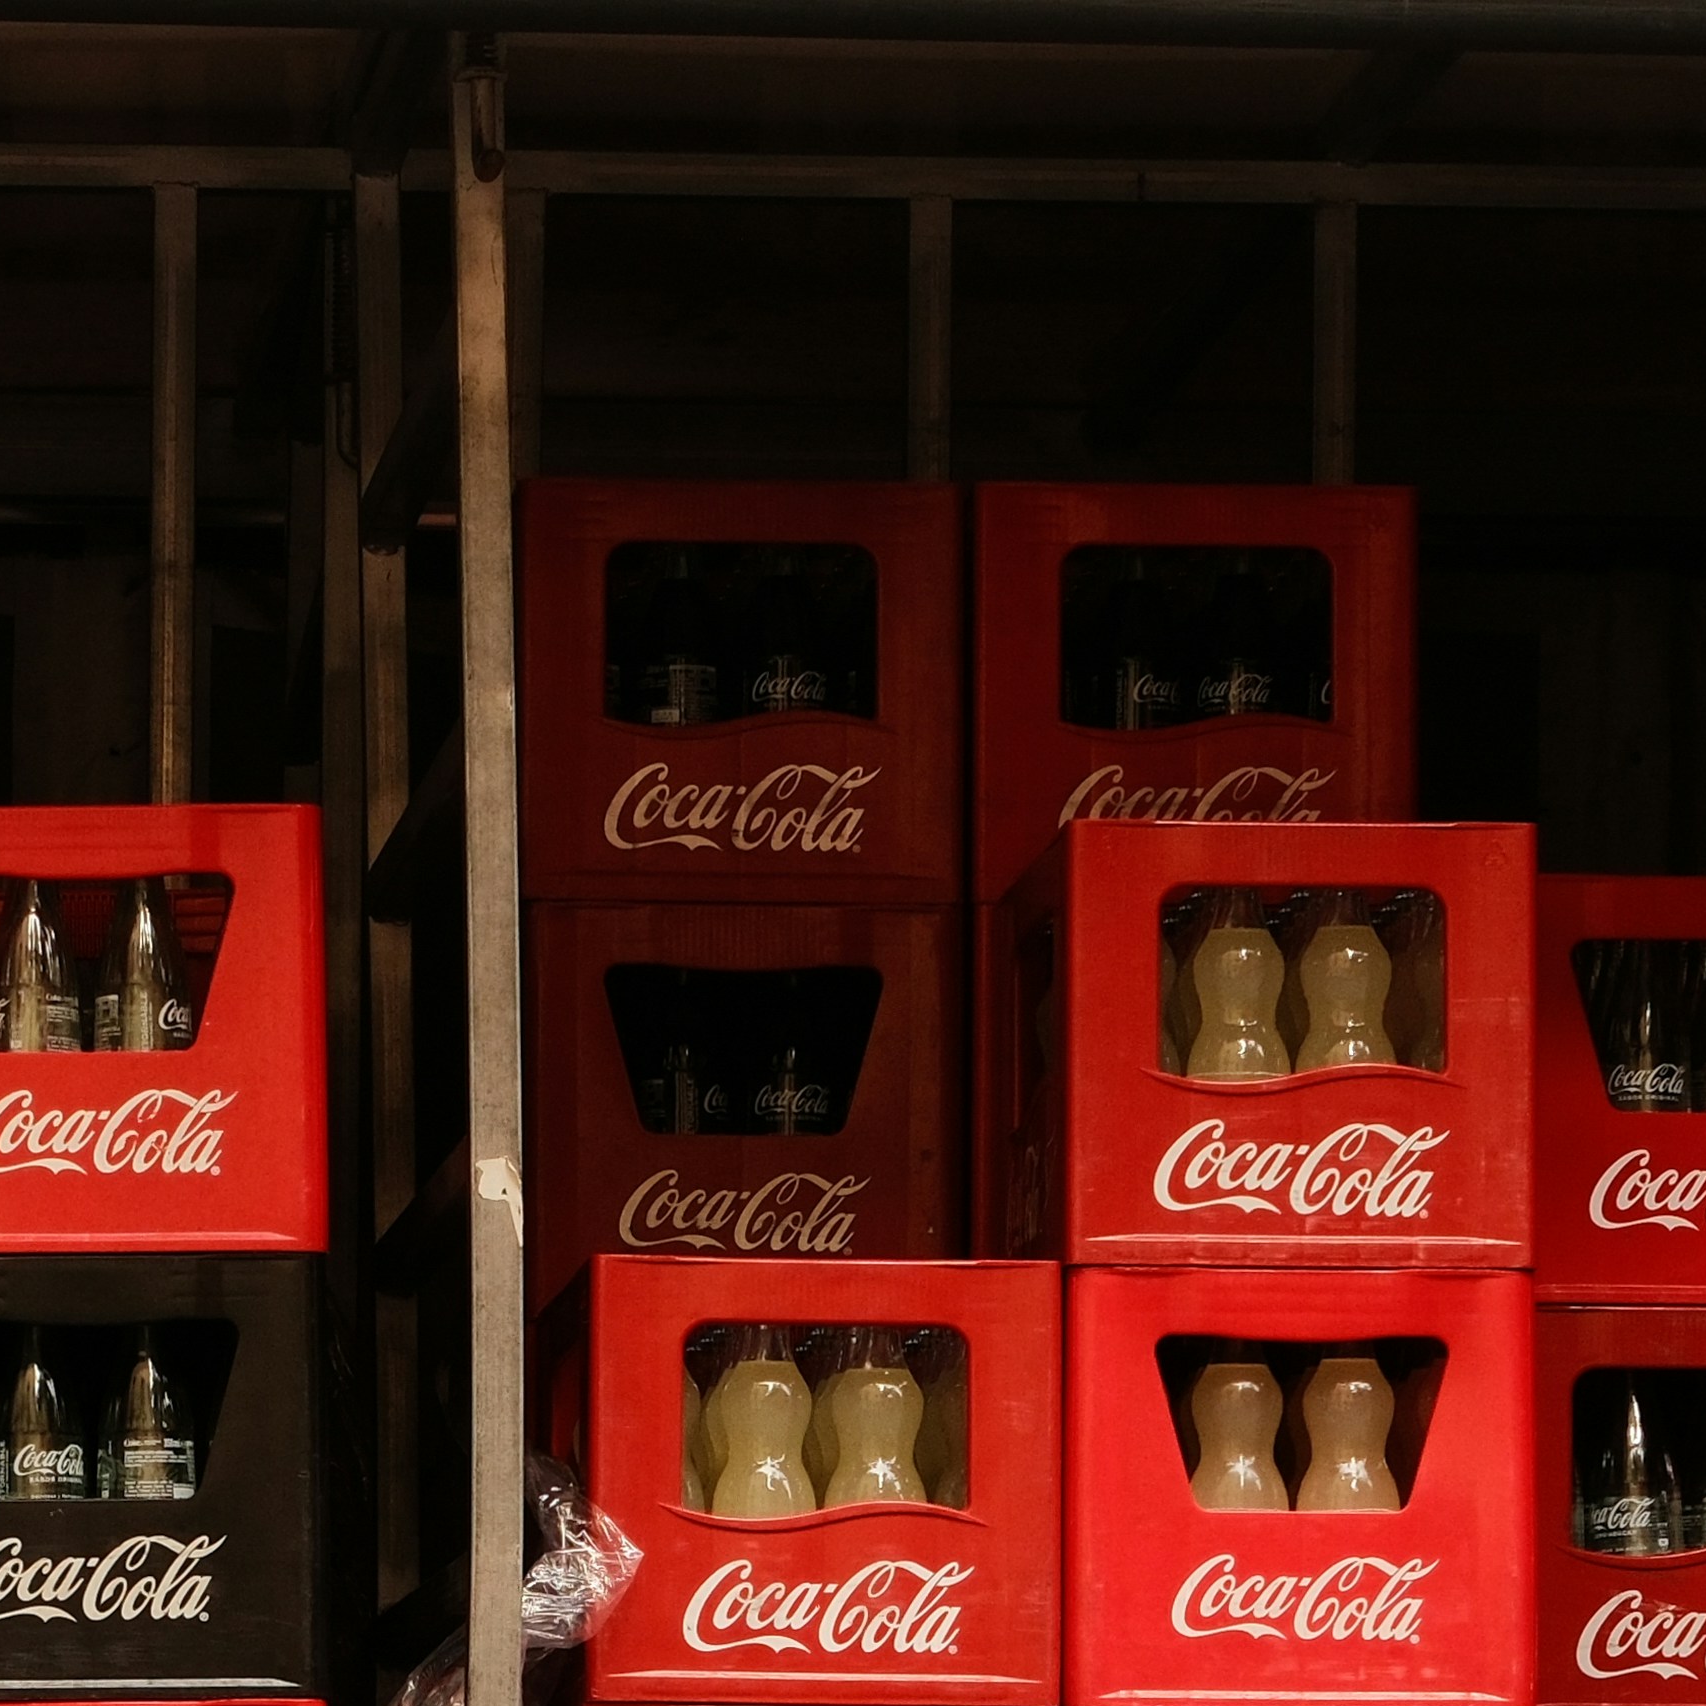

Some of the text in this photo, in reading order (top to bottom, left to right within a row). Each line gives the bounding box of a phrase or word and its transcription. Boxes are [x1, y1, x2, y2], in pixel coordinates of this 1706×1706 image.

[605, 763, 880, 851] Coca-Cola
[1608, 1062, 1686, 1095] Coca-Cola
[619, 1170, 869, 1252] Coca-Cola
[1154, 1119, 1449, 1217] Coca-Cola
[683, 1560, 974, 1653] Coca-Cola
[1172, 1554, 1438, 1643] Coca-Cola
